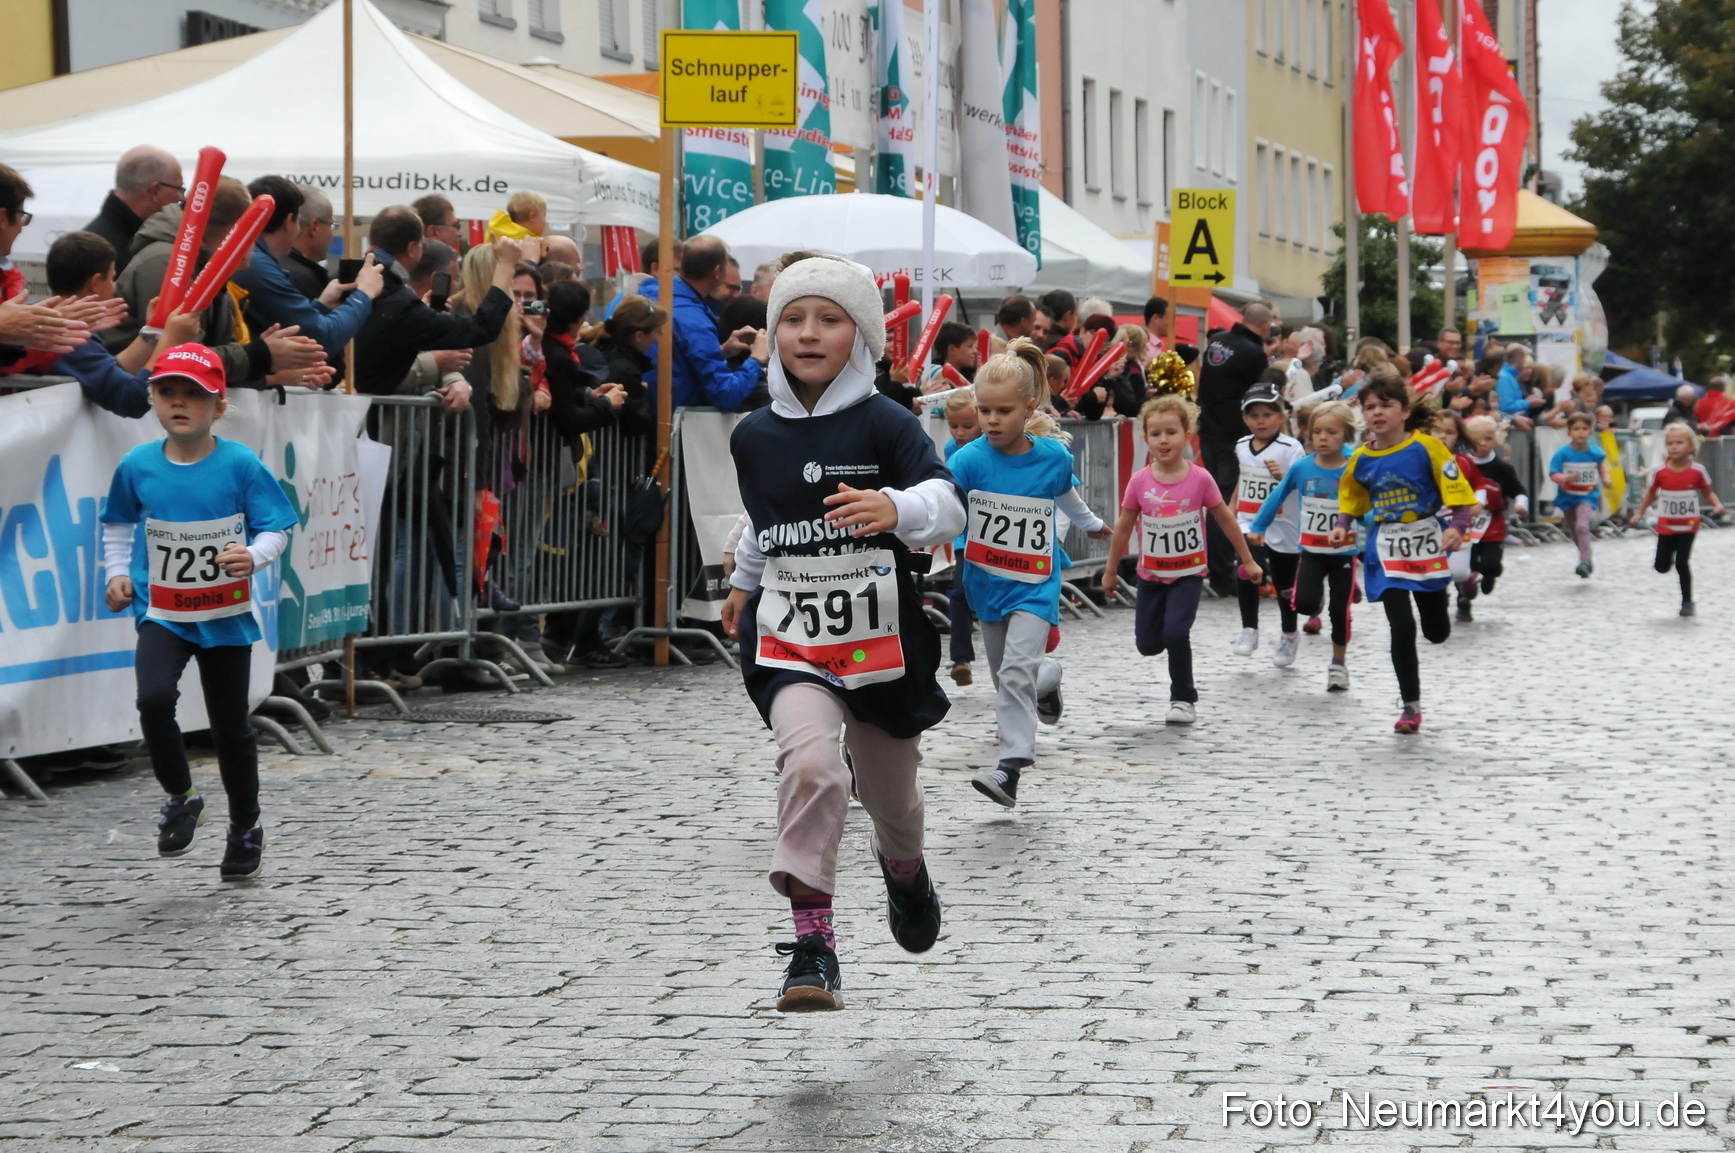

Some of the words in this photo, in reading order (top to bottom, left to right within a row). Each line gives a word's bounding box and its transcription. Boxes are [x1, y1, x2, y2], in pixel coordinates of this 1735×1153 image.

[671, 58, 788, 81] Schnupper-
[711, 85, 747, 103] lauf
[684, 127, 750, 149] smeist
[1178, 192, 1228, 210] Block
[179, 223, 198, 252] BKK
[1183, 218, 1219, 265] A
[170, 254, 189, 287] Audi
[874, 267, 909, 281] udi
[970, 497, 998, 510] PARTL
[1000, 503, 1042, 515] Neumarkt
[1663, 500, 1696, 515] 7084
[146, 528, 177, 542] PARTL
[179, 528, 231, 542] Neumarkt
[977, 510, 1046, 551] 7213
[1147, 527, 1199, 554] 7103
[1384, 531, 1440, 558] 7075
[156, 541, 238, 583] 723
[985, 550, 1030, 570] Carlotta
[799, 566, 870, 583] Neumarkt
[173, 591, 225, 609] Sophia
[776, 581, 880, 639] 7591
